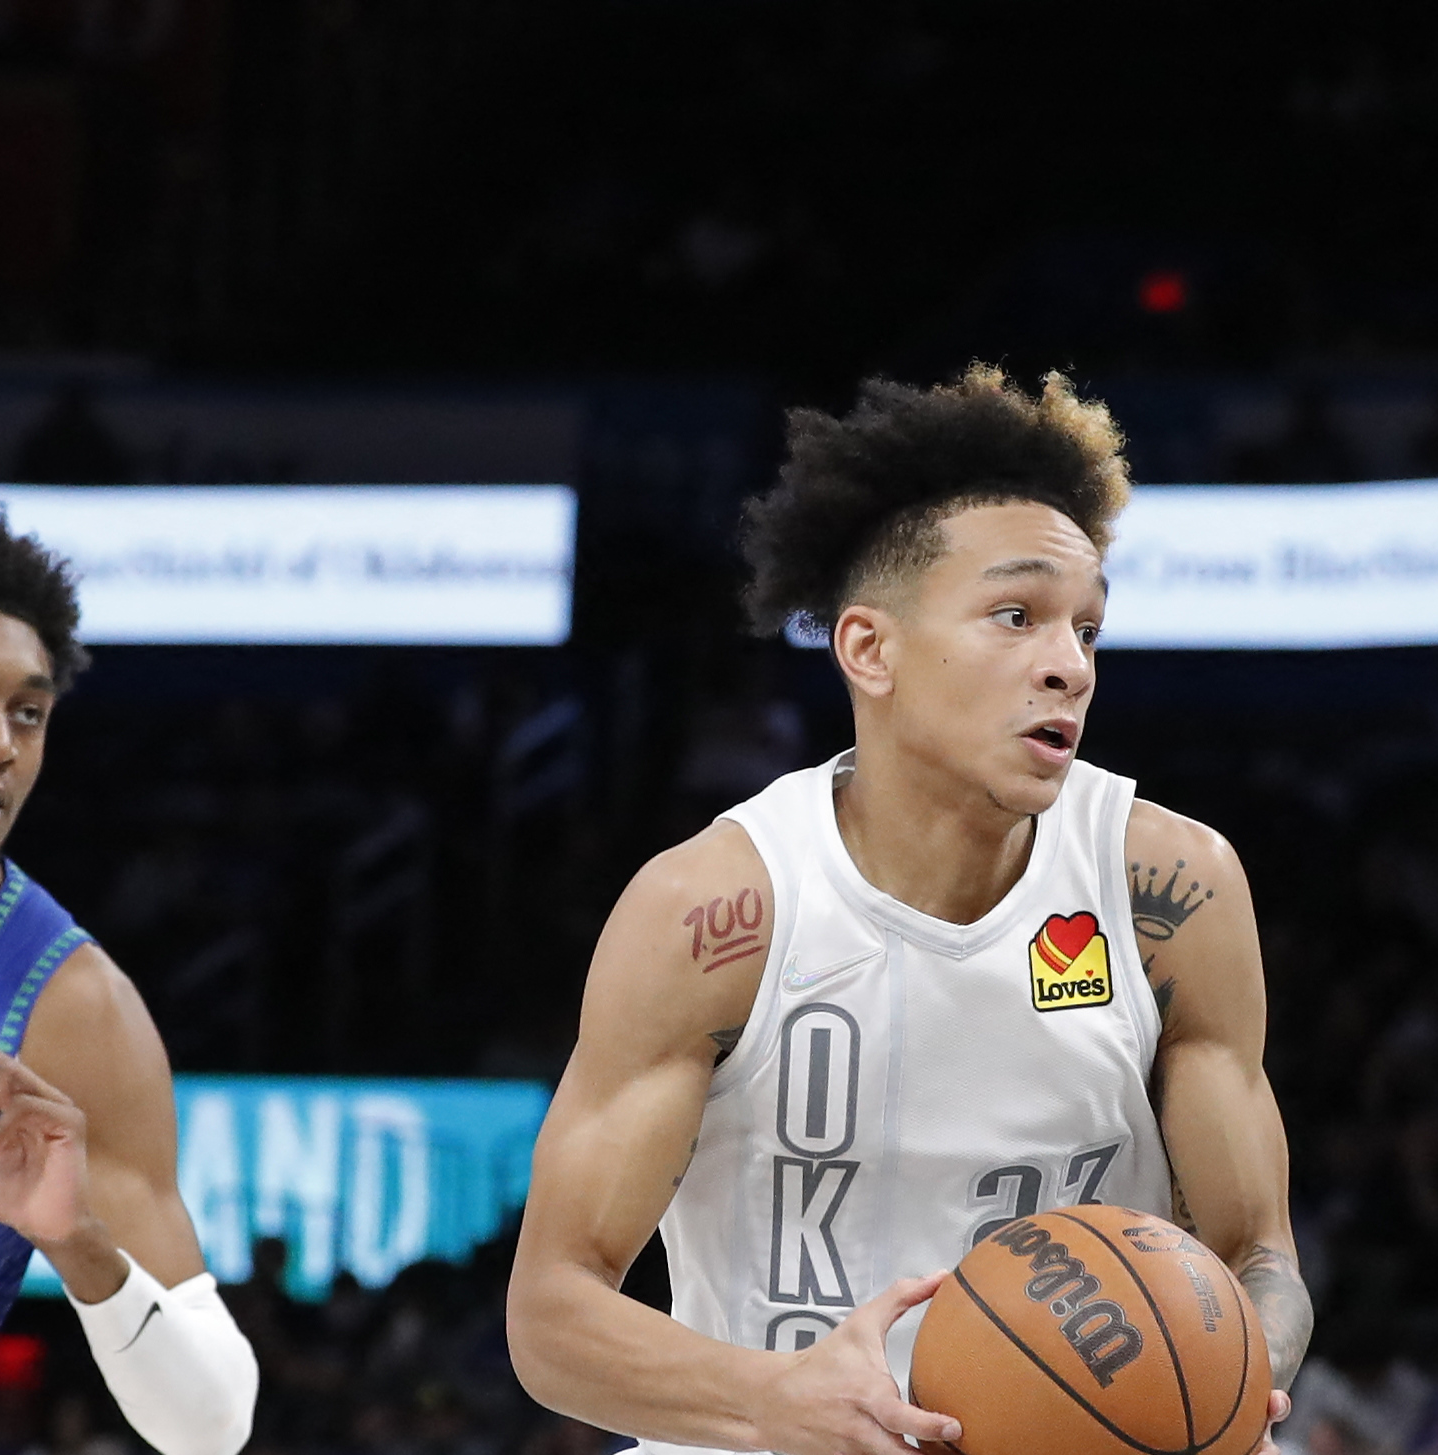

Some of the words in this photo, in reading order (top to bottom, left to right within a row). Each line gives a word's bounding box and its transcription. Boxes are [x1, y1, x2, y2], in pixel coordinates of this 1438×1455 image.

[682, 887, 764, 961] 100
[178, 1092, 429, 1292] AND
[991, 1219, 1144, 1389] Wilson
